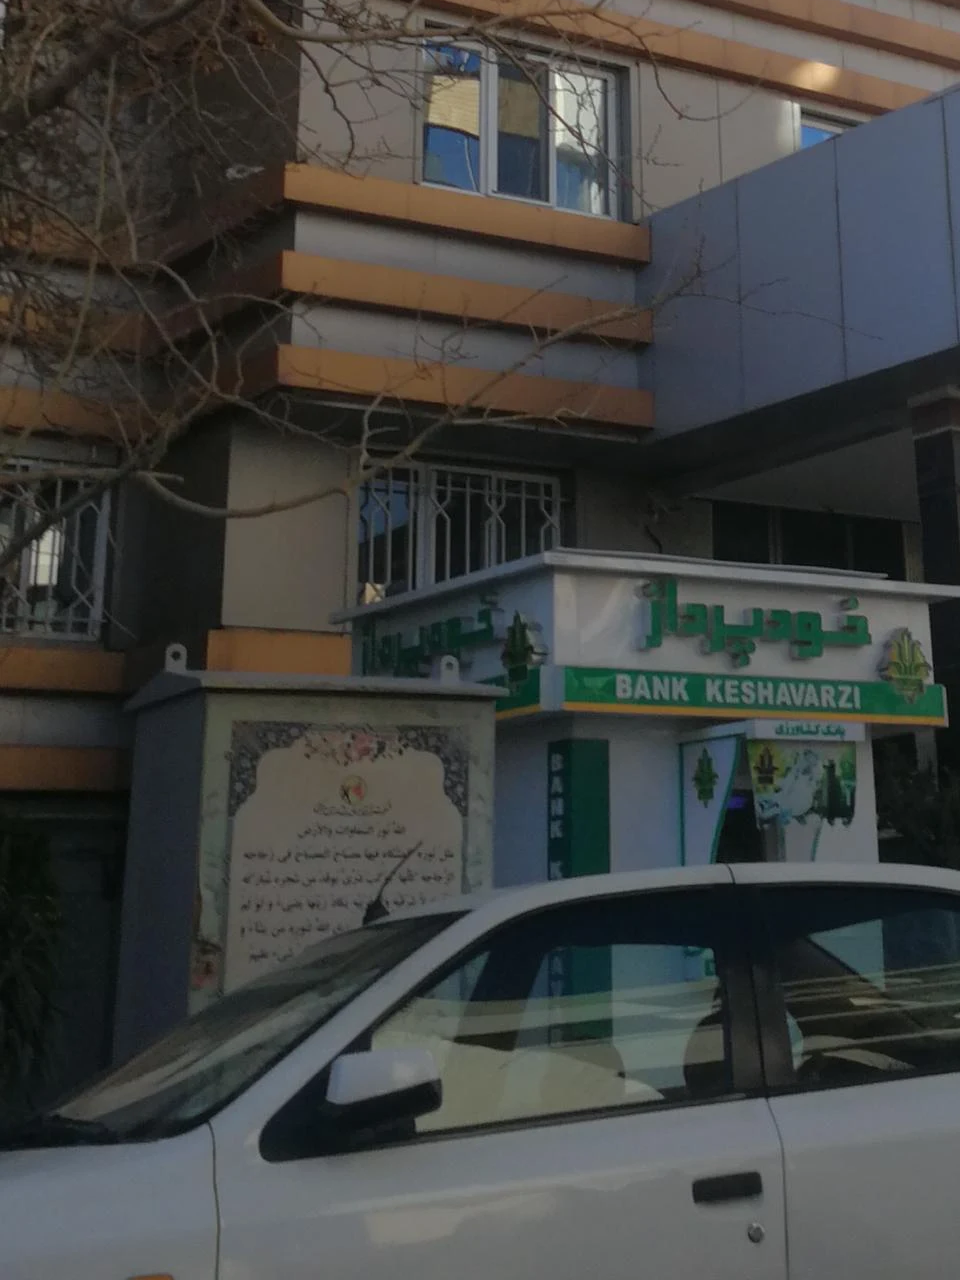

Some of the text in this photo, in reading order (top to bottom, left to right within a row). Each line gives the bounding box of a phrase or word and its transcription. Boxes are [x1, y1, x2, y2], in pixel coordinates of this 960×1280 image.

[640, 577, 871, 667] خودپرداز
[615, 673, 862, 709] BANK KESHAVARZI
[550, 752, 565, 838] BANK
